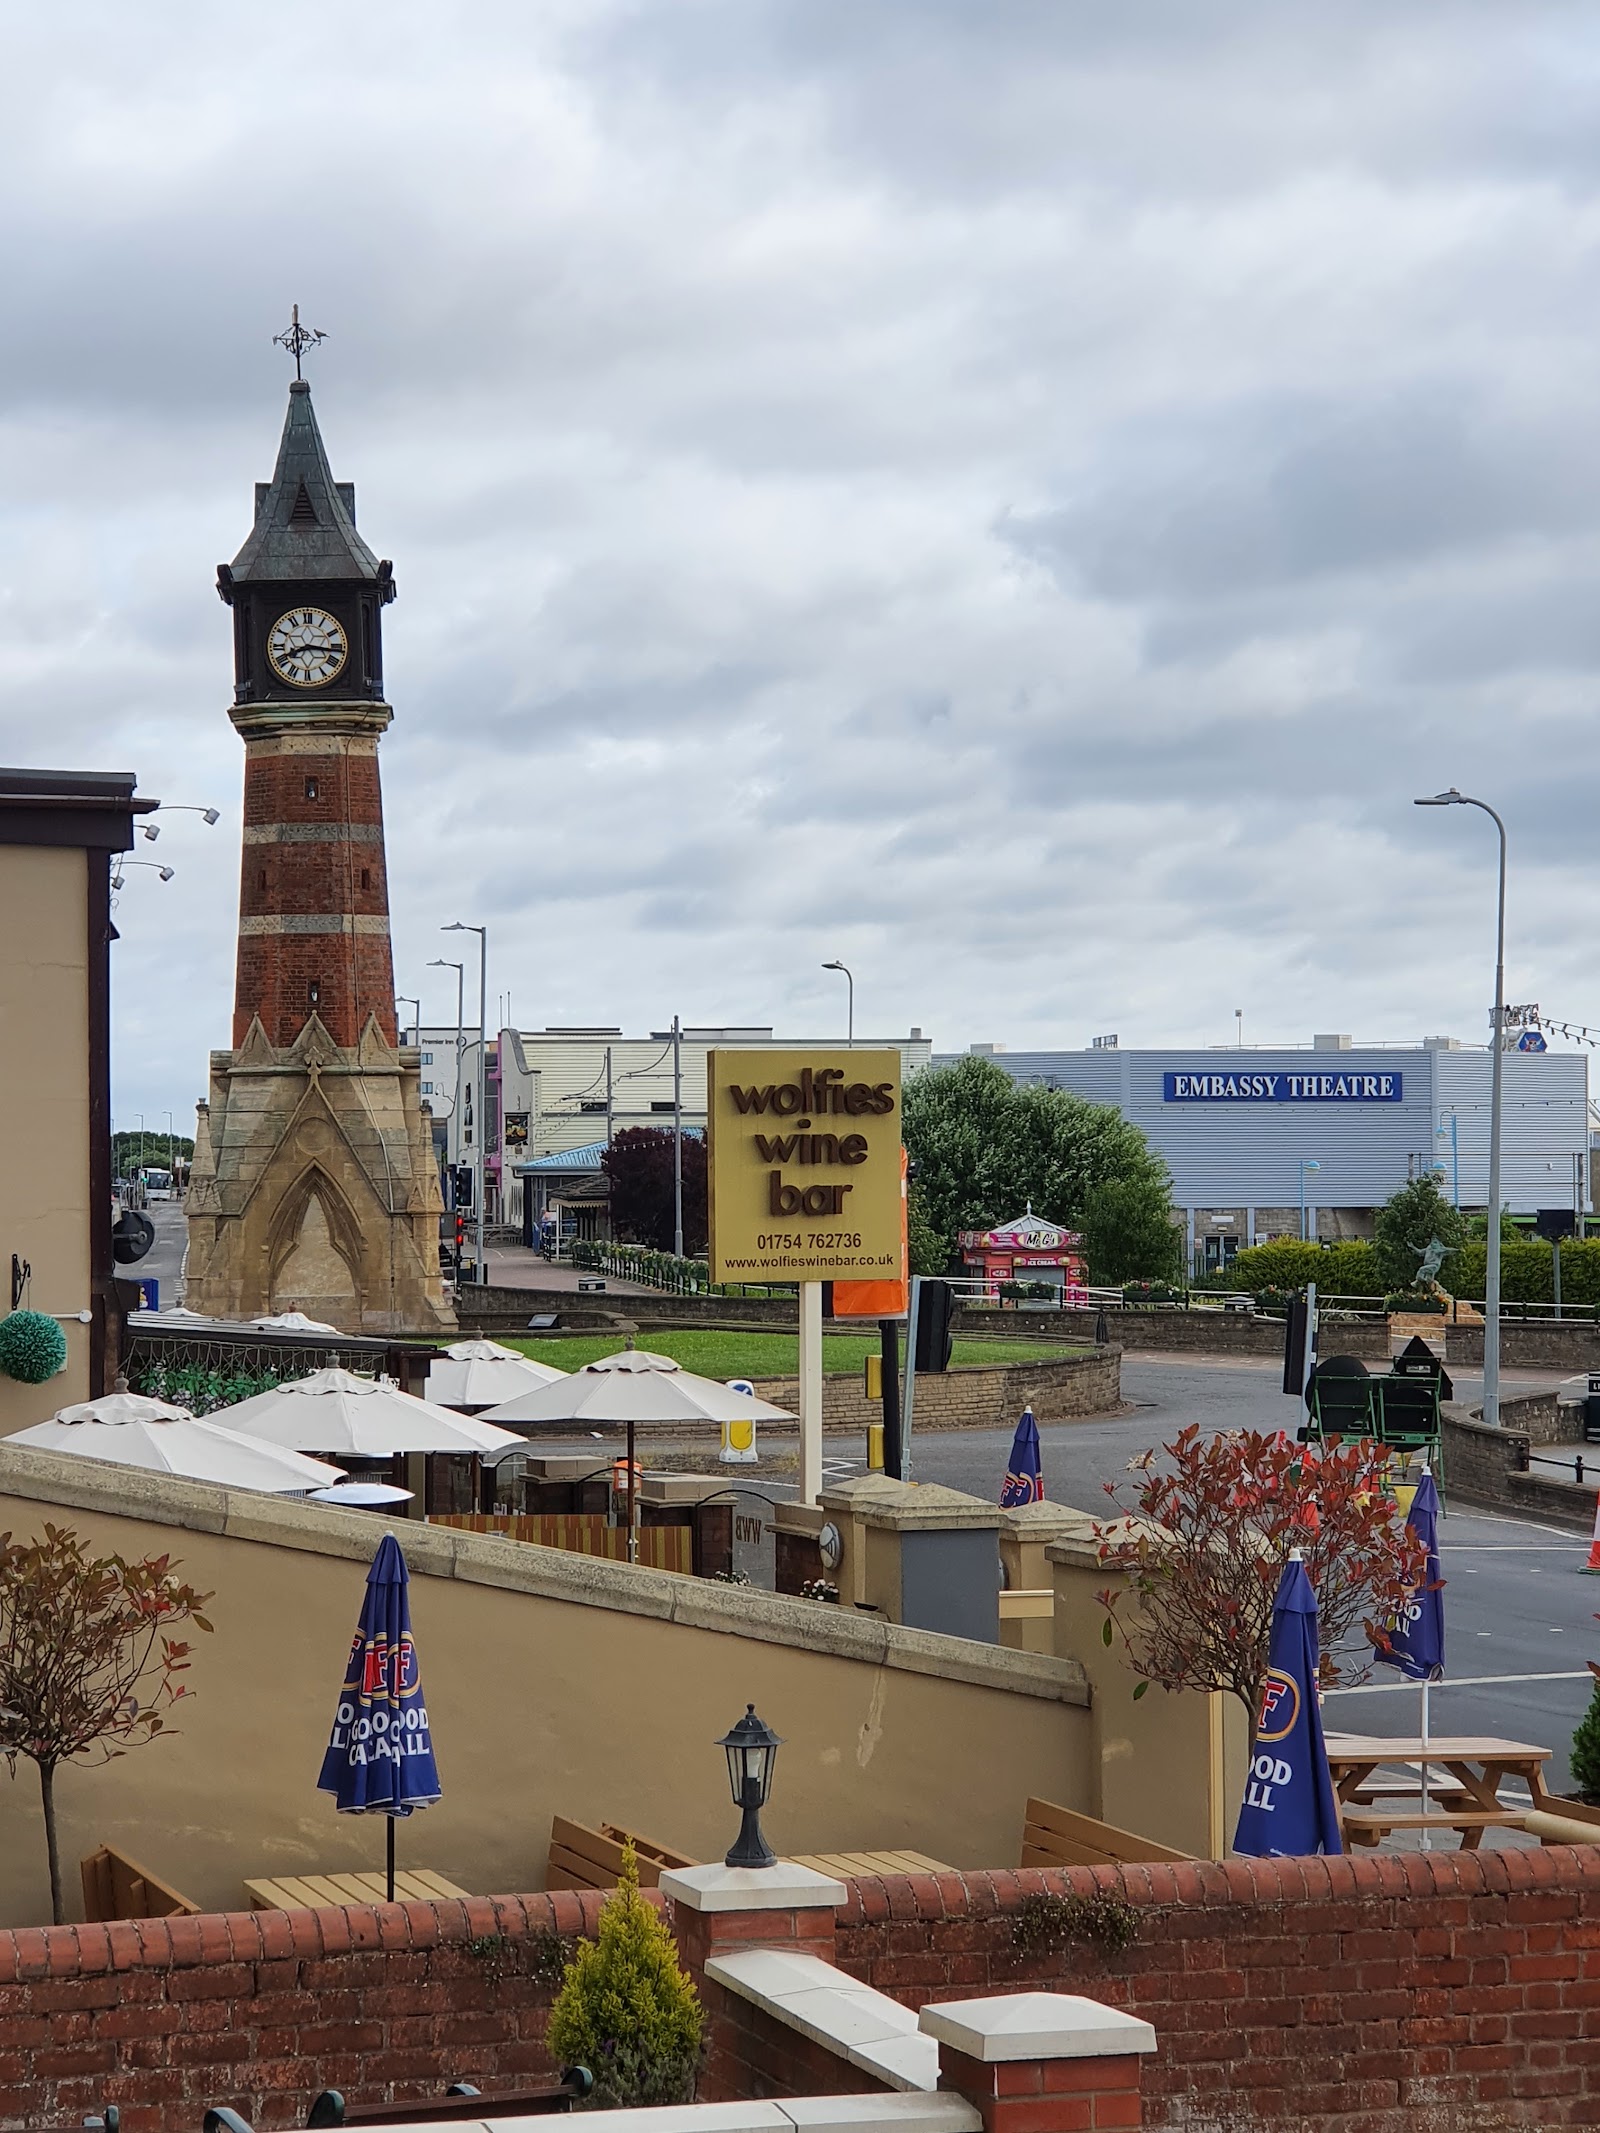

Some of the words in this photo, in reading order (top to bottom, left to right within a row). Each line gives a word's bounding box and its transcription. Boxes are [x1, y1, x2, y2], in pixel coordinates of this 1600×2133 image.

[729, 1067, 895, 1116] wolfies
[1174, 1075, 1279, 1098] EMBASSY
[1287, 1075, 1394, 1098] THEATRE
[754, 1118, 869, 1165] wine
[769, 1170, 854, 1217] bar
[757, 1234, 802, 1249] 01754
[807, 1233, 862, 1249] 762736
[725, 1254, 894, 1268] www.wolfieswinebar.co.uk
[1258, 1680, 1287, 1729] F
[1243, 1781, 1275, 1811] LL
